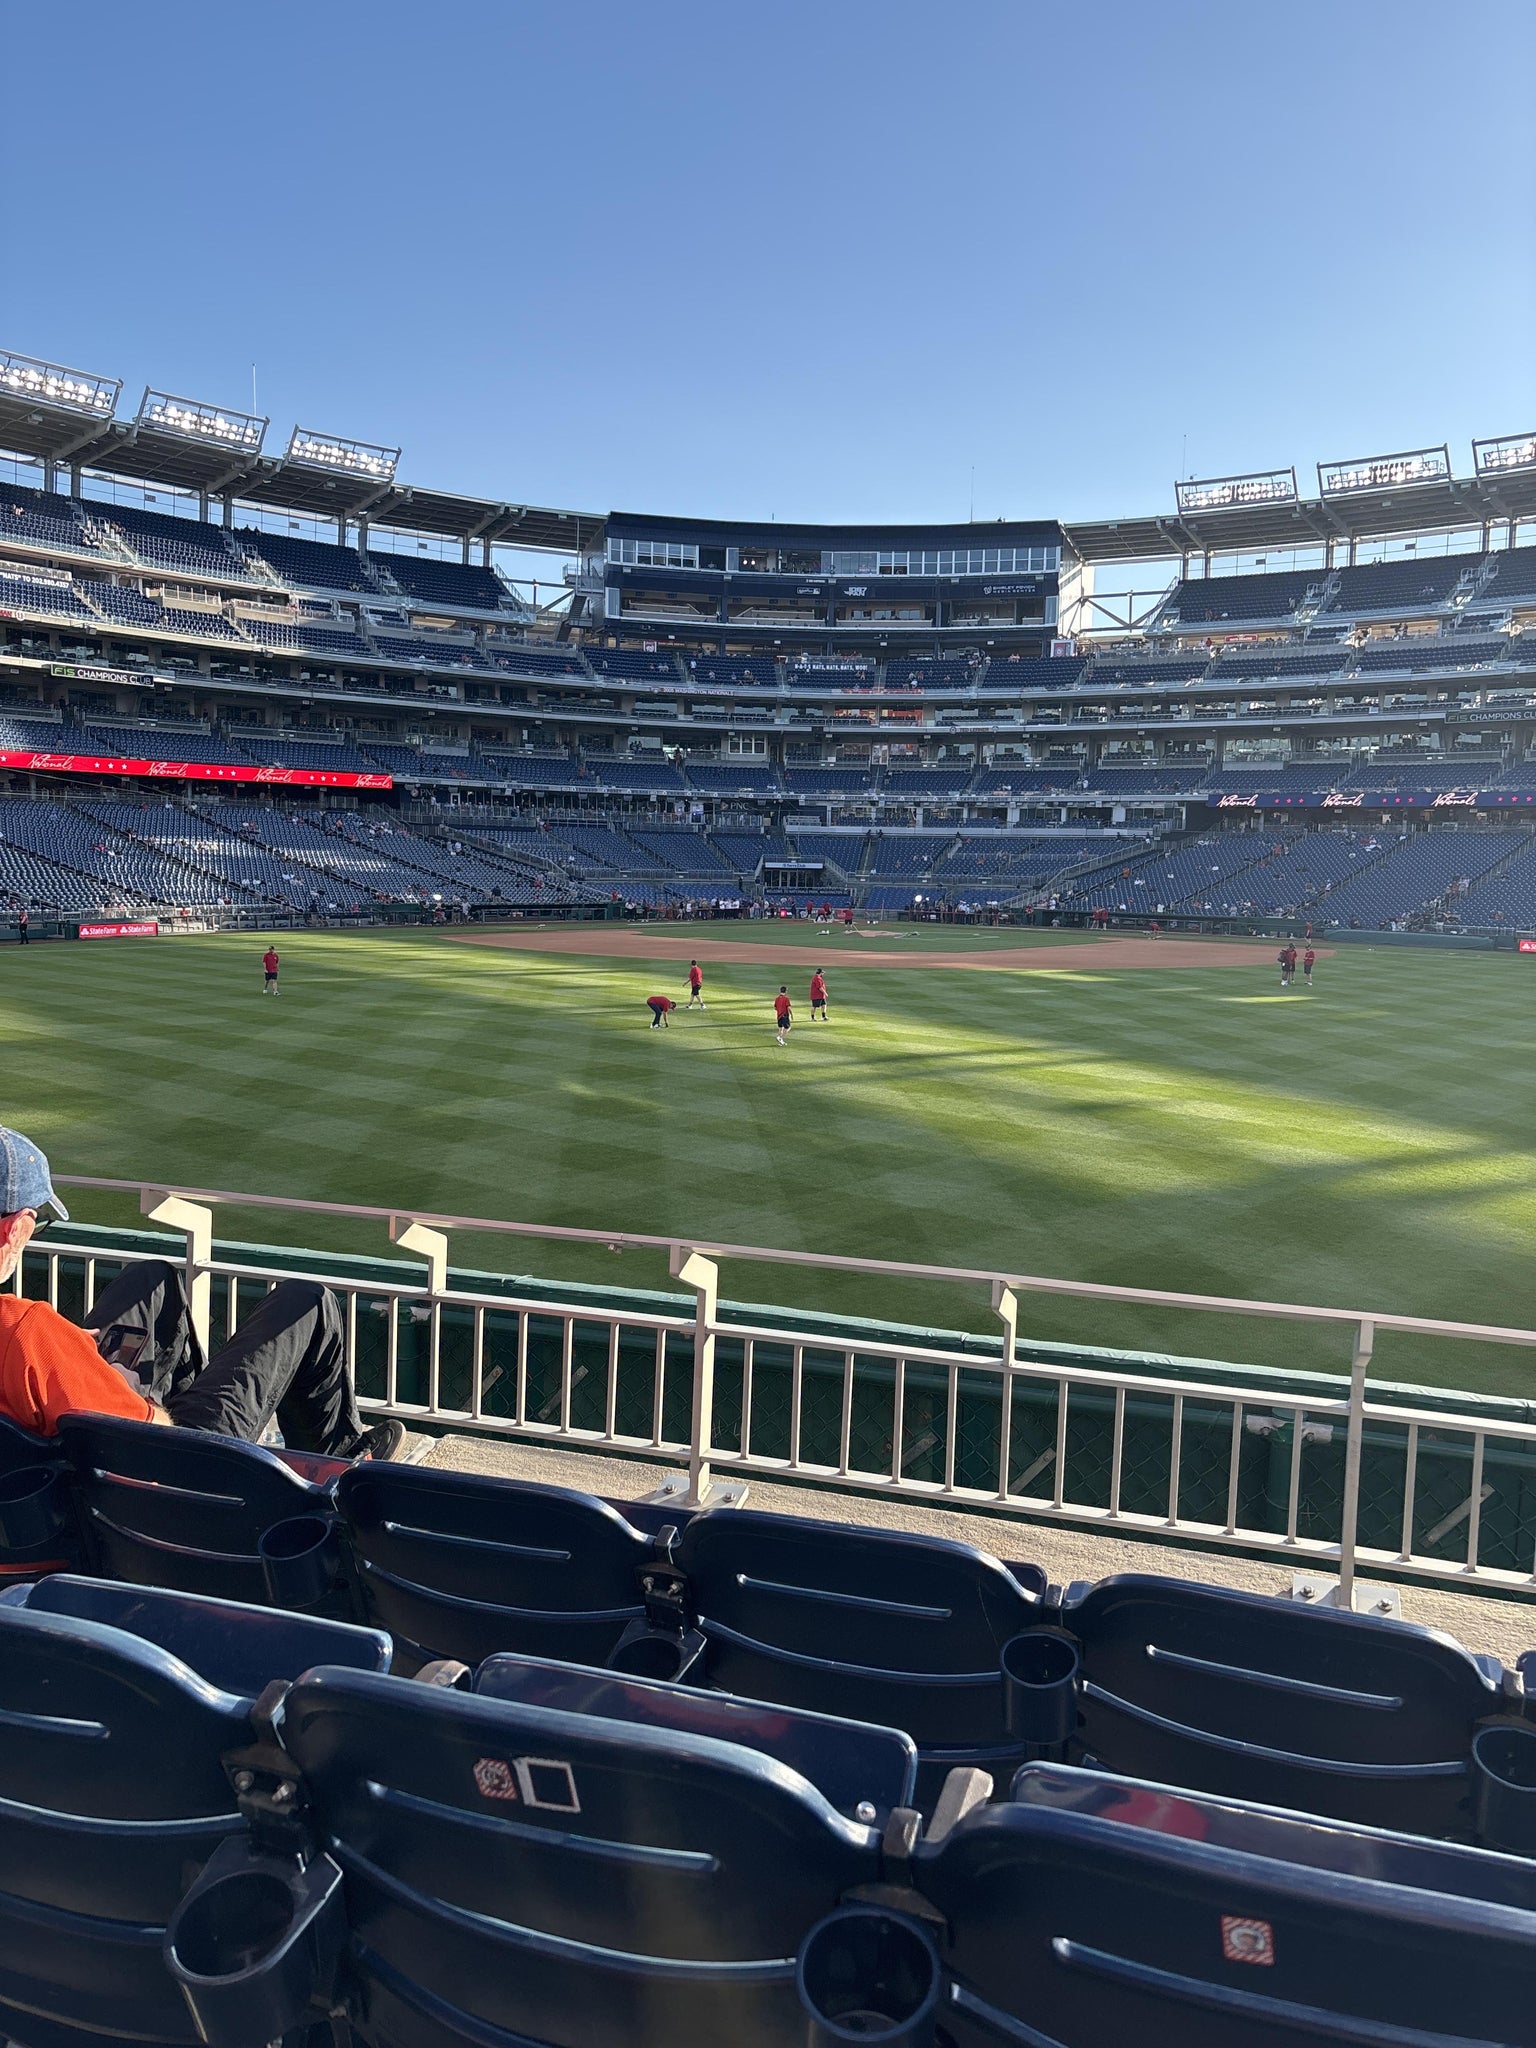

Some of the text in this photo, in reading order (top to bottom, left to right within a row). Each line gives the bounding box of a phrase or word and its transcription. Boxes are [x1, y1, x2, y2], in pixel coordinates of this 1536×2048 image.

[22, 575, 31, 583] TO
[54, 667, 152, 685] FIS CHAMPIONS CLUB
[1469, 711, 1522, 722] CHAMPIONS
[26, 753, 393, 789] Nationals Nationals Nationals Nationals
[730, 801, 750, 810] PNC
[1216, 792, 1479, 808] Nationals Nationals Nationals
